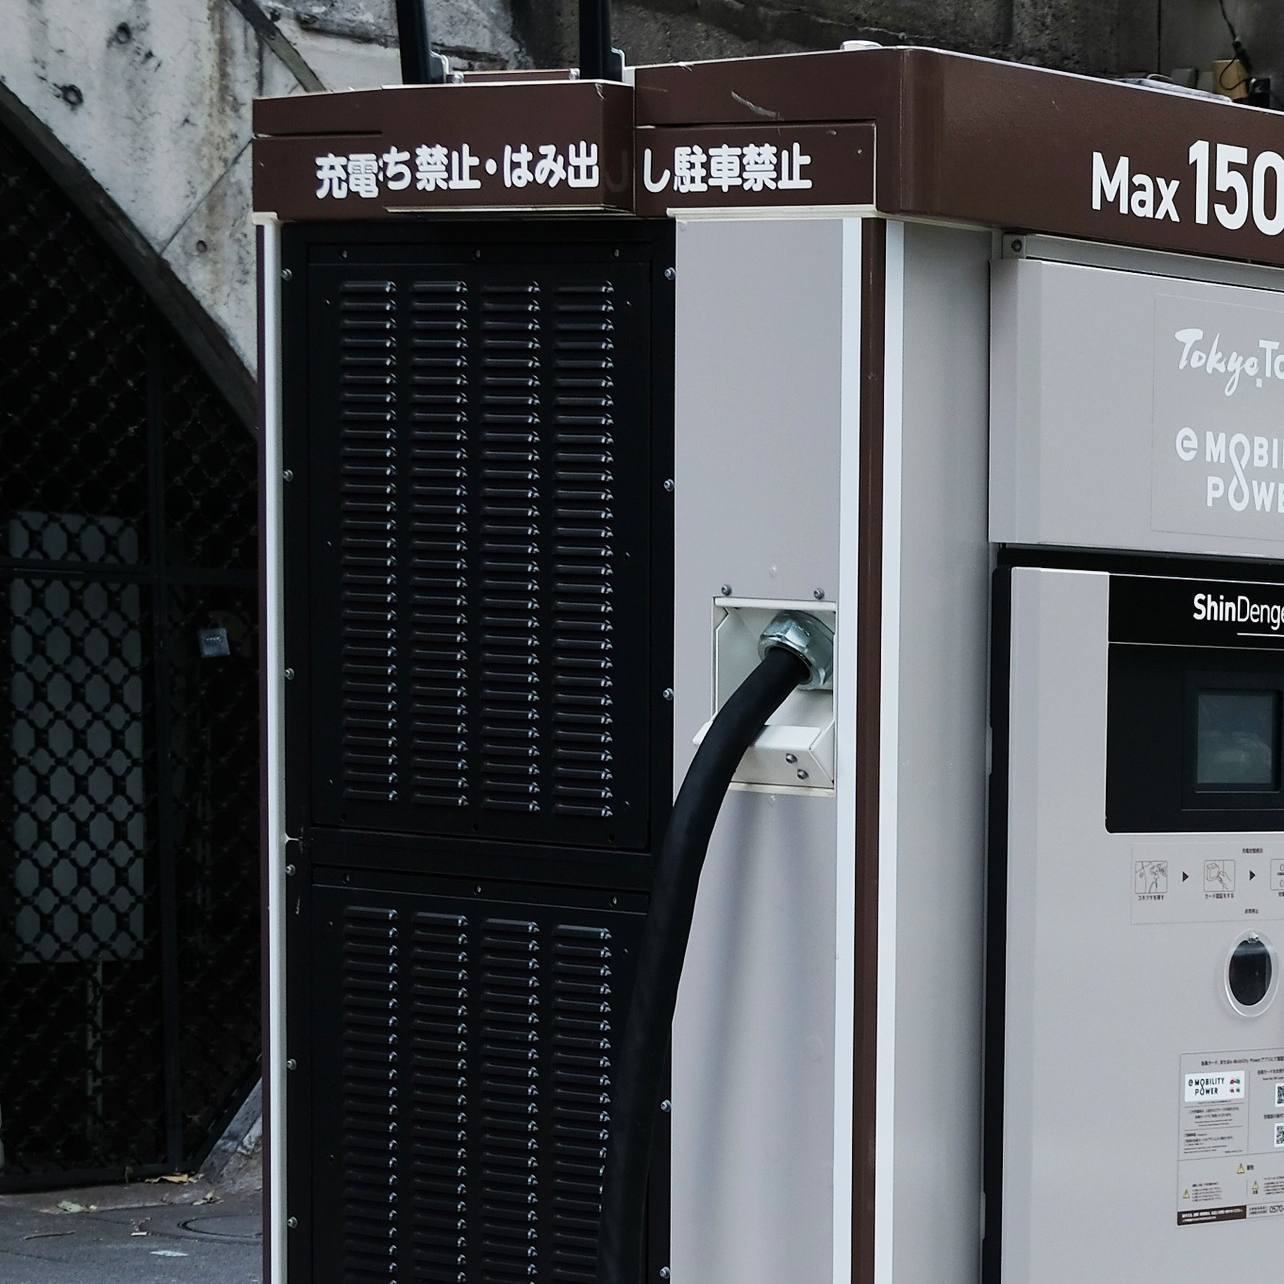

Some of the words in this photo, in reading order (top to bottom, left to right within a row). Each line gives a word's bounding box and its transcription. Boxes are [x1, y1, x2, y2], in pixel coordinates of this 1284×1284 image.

[315, 141, 599, 199] 充電ち禁止・はみ出
[643, 141, 813, 193] し駐車禁止
[1092, 152, 1180, 222] Max
[1175, 328, 1260, 396] Tokyo
[1194, 1087, 1219, 1096] POWER
